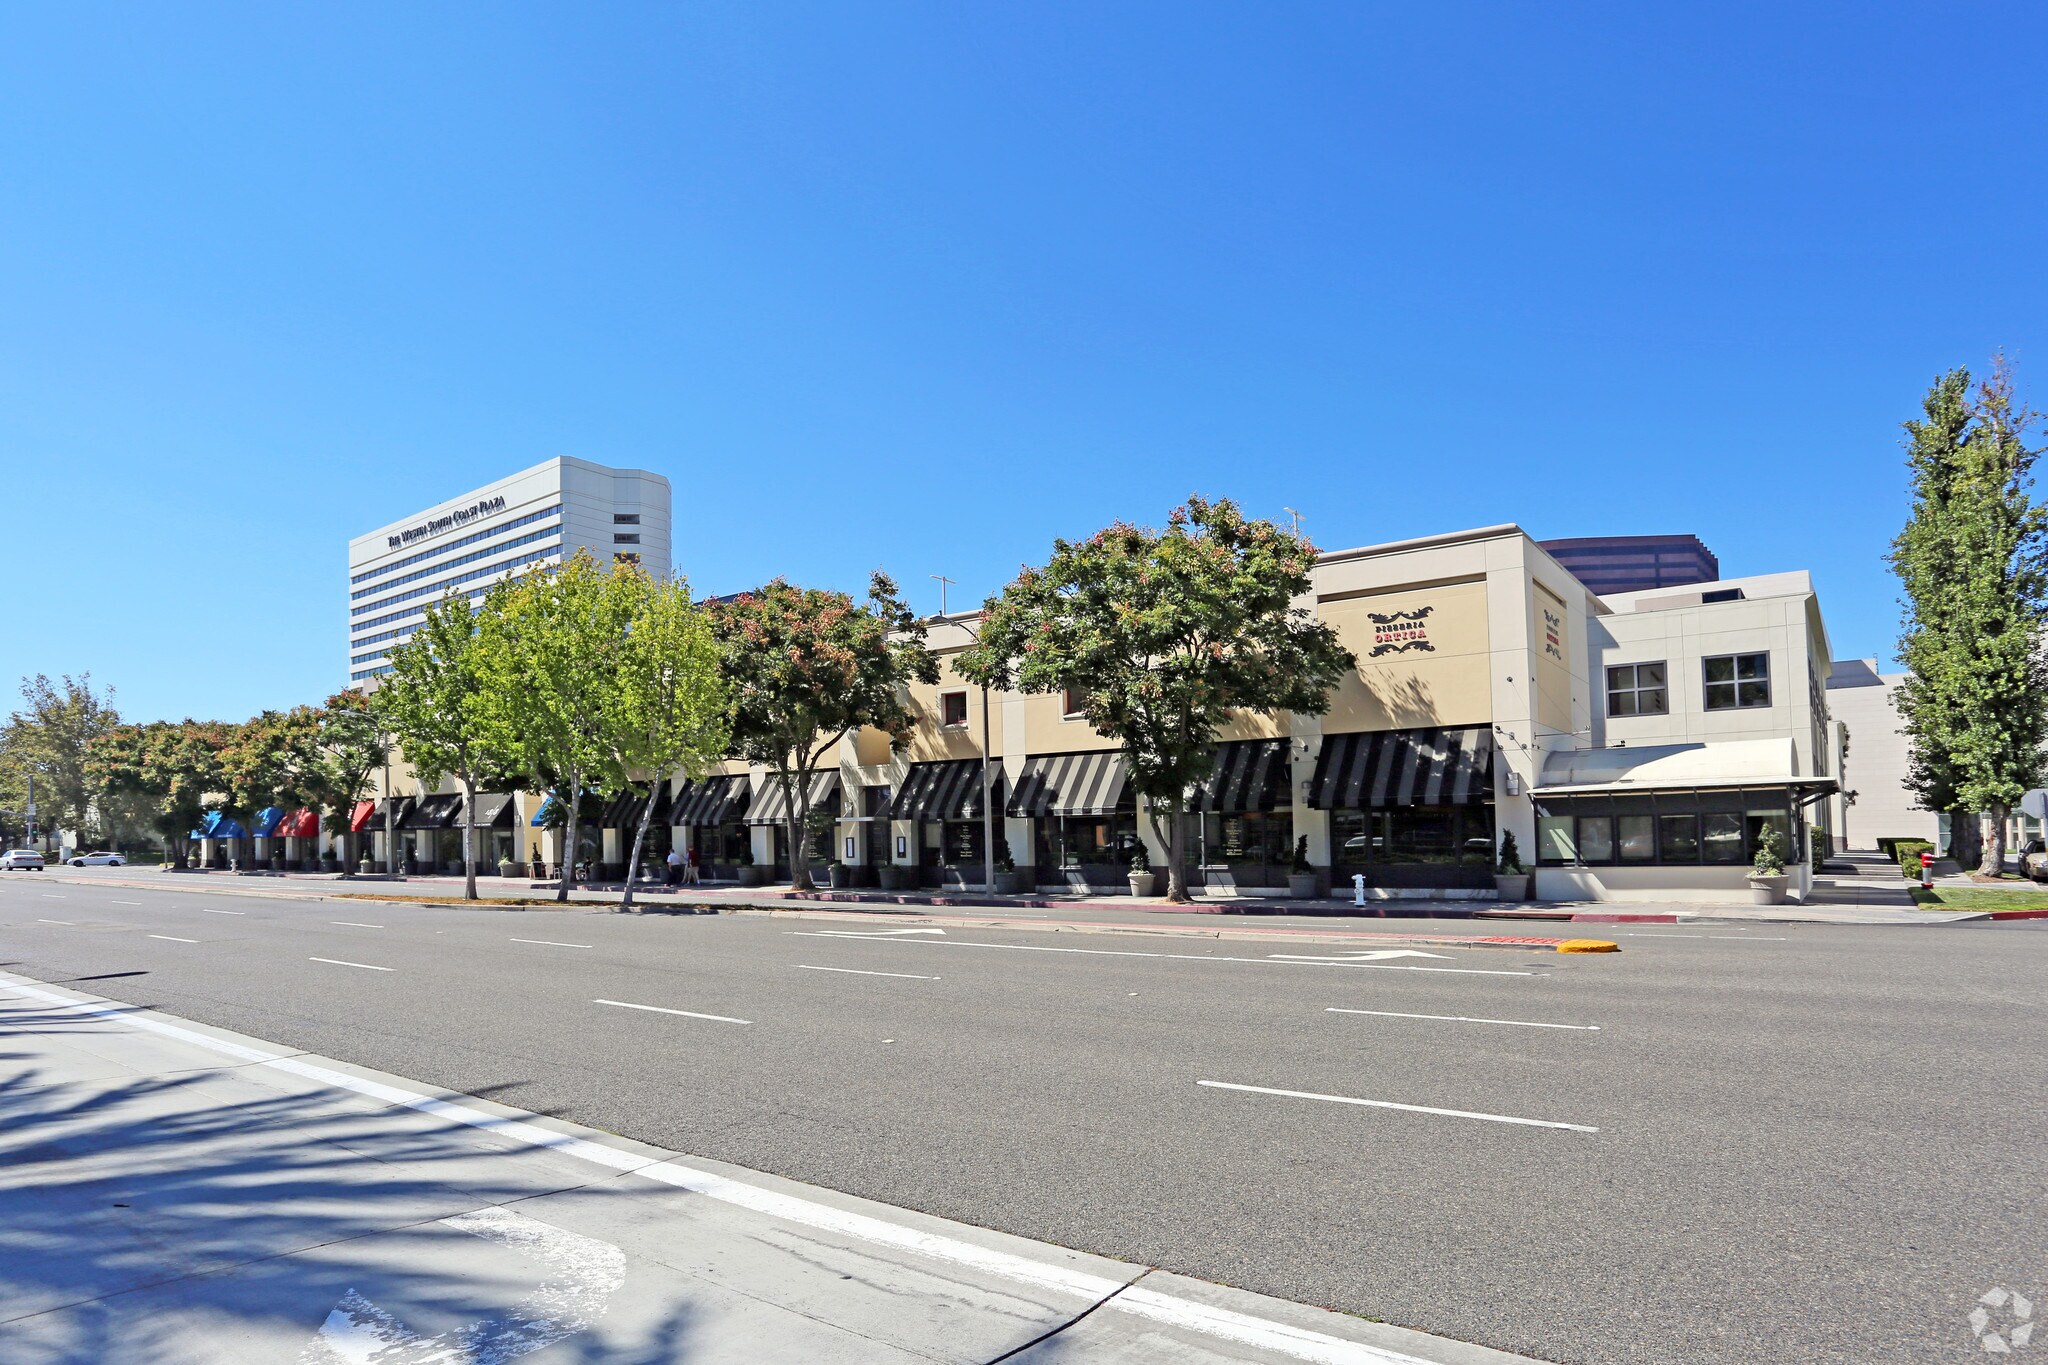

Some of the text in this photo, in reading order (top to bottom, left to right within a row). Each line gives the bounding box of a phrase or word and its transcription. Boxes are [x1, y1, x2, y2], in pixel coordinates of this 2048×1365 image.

[428, 515, 453, 532] SOUTH
[453, 505, 478, 522] COAST
[479, 496, 505, 513] PLAZA
[1375, 621, 1425, 633] PIZZERIA
[1375, 629, 1427, 643] ORTICA
